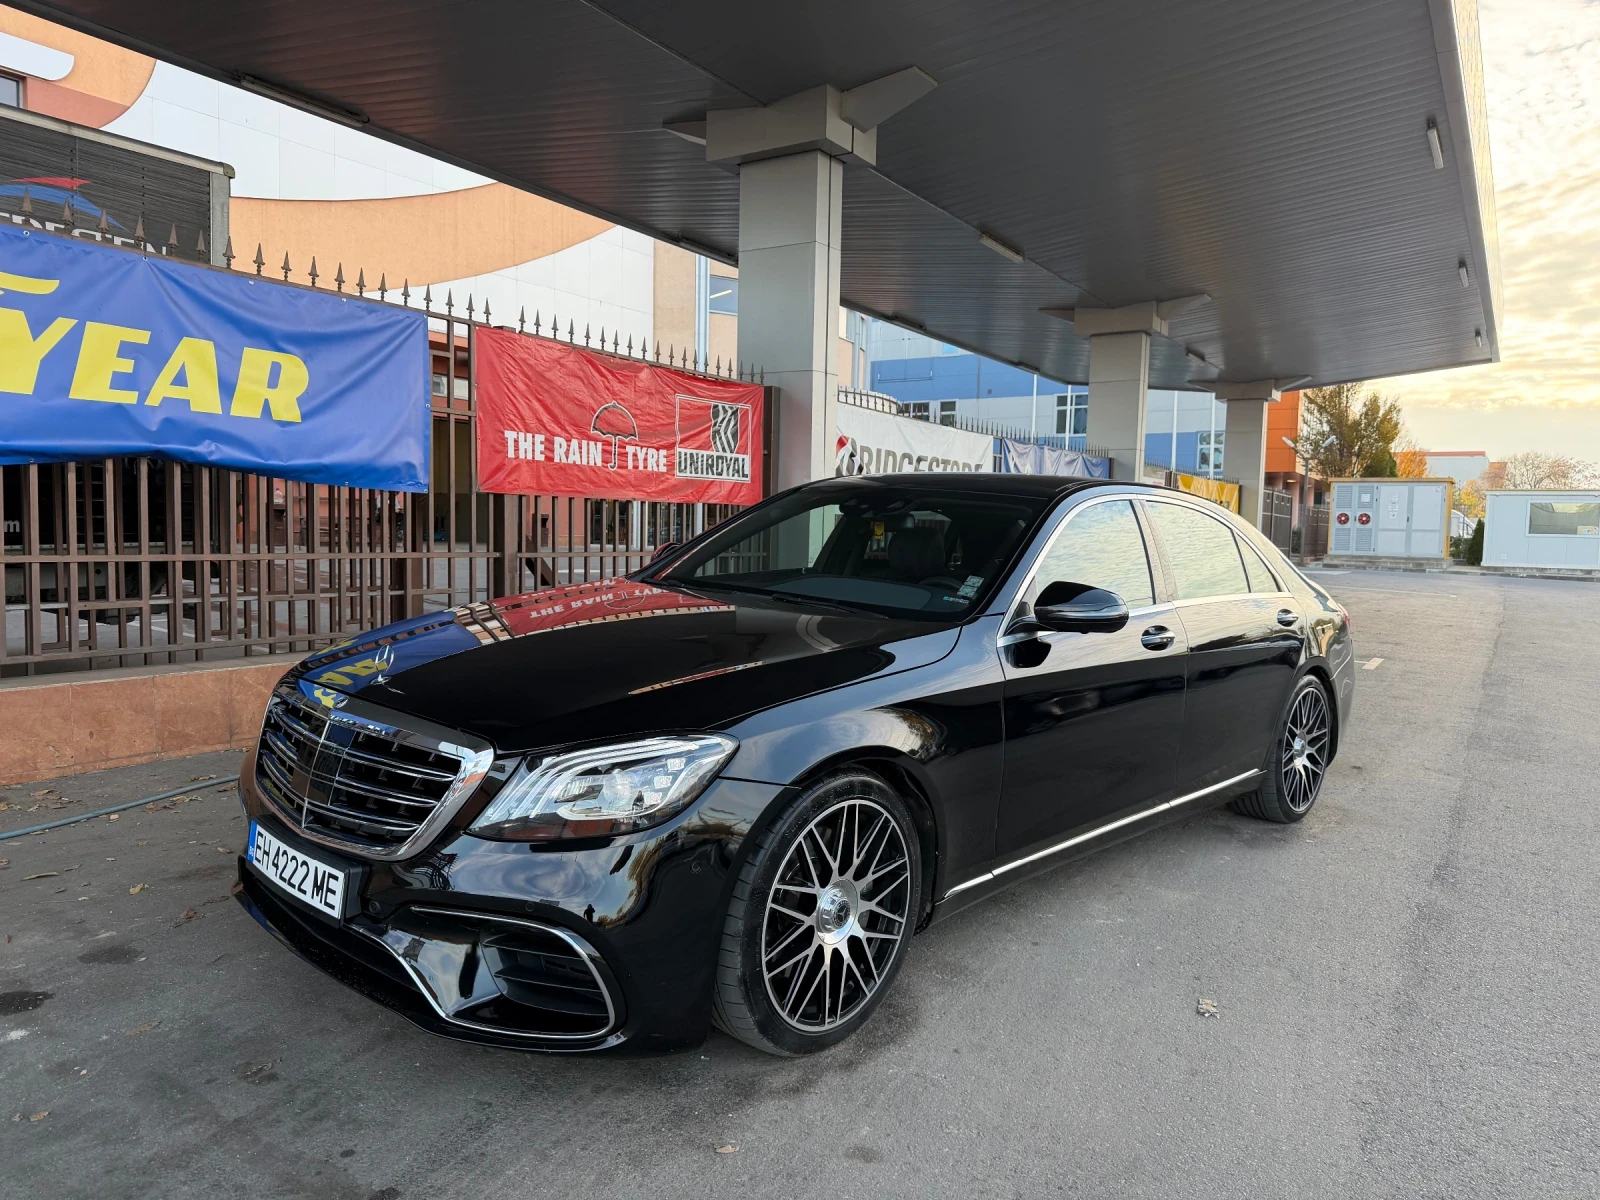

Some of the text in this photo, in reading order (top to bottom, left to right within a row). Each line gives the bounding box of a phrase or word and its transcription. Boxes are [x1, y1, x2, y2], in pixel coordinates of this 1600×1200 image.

[0, 307, 309, 423] YEAR
[504, 430, 667, 472] THE RAIN TYRE
[677, 450, 749, 479] UNIROYAL
